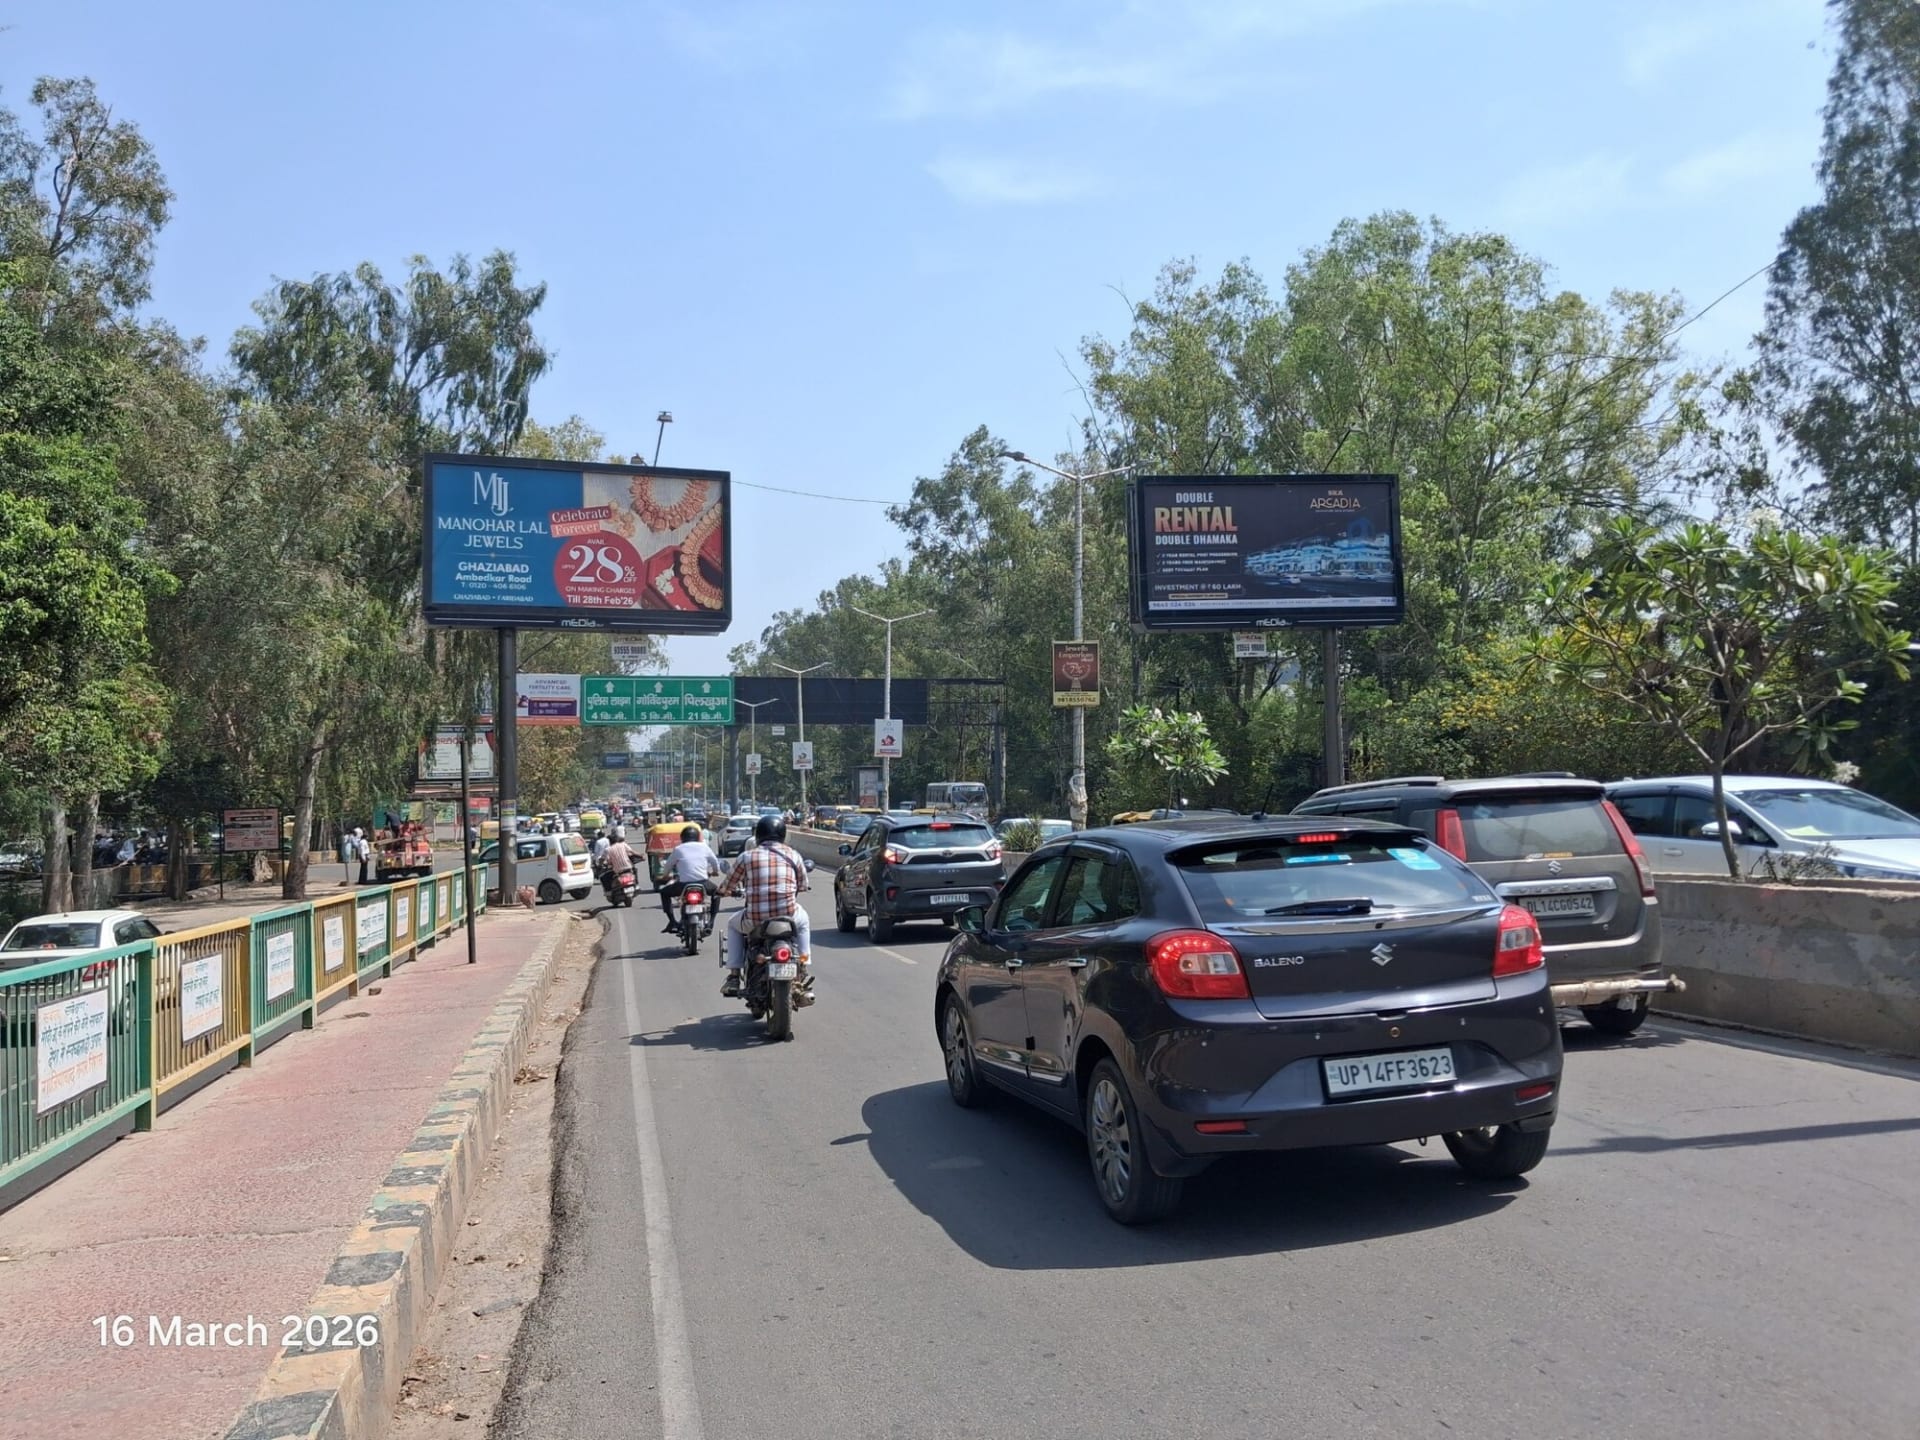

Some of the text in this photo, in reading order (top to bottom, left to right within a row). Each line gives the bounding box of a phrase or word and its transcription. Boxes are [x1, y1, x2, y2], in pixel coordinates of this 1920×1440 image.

[1176, 492, 1214, 503] DOUBLE
[1310, 497, 1361, 508] ARCADIA
[552, 508, 609, 523] Celebrate
[1154, 506, 1238, 532] RENTAL
[438, 516, 548, 535] MANOHAR LAL
[555, 523, 598, 535] Forever
[464, 535, 523, 549] JEWELS
[1155, 534, 1238, 545] DOUBLE DHAMAKA
[458, 561, 529, 573] GHAZIABAD
[456, 572, 532, 583] Ambedkar Road
[1154, 583, 1198, 591] INVESTMENT
[567, 595, 581, 604] Till
[583, 596, 602, 605] 28th
[587, 693, 609, 710] पुलिस
[610, 696, 631, 706] लाइन
[591, 712, 598, 720] 4
[640, 712, 647, 720] 5
[688, 712, 698, 720] 21
[1254, 956, 1304, 968] BALENO
[1338, 1055, 1452, 1086] UP14FF3623
